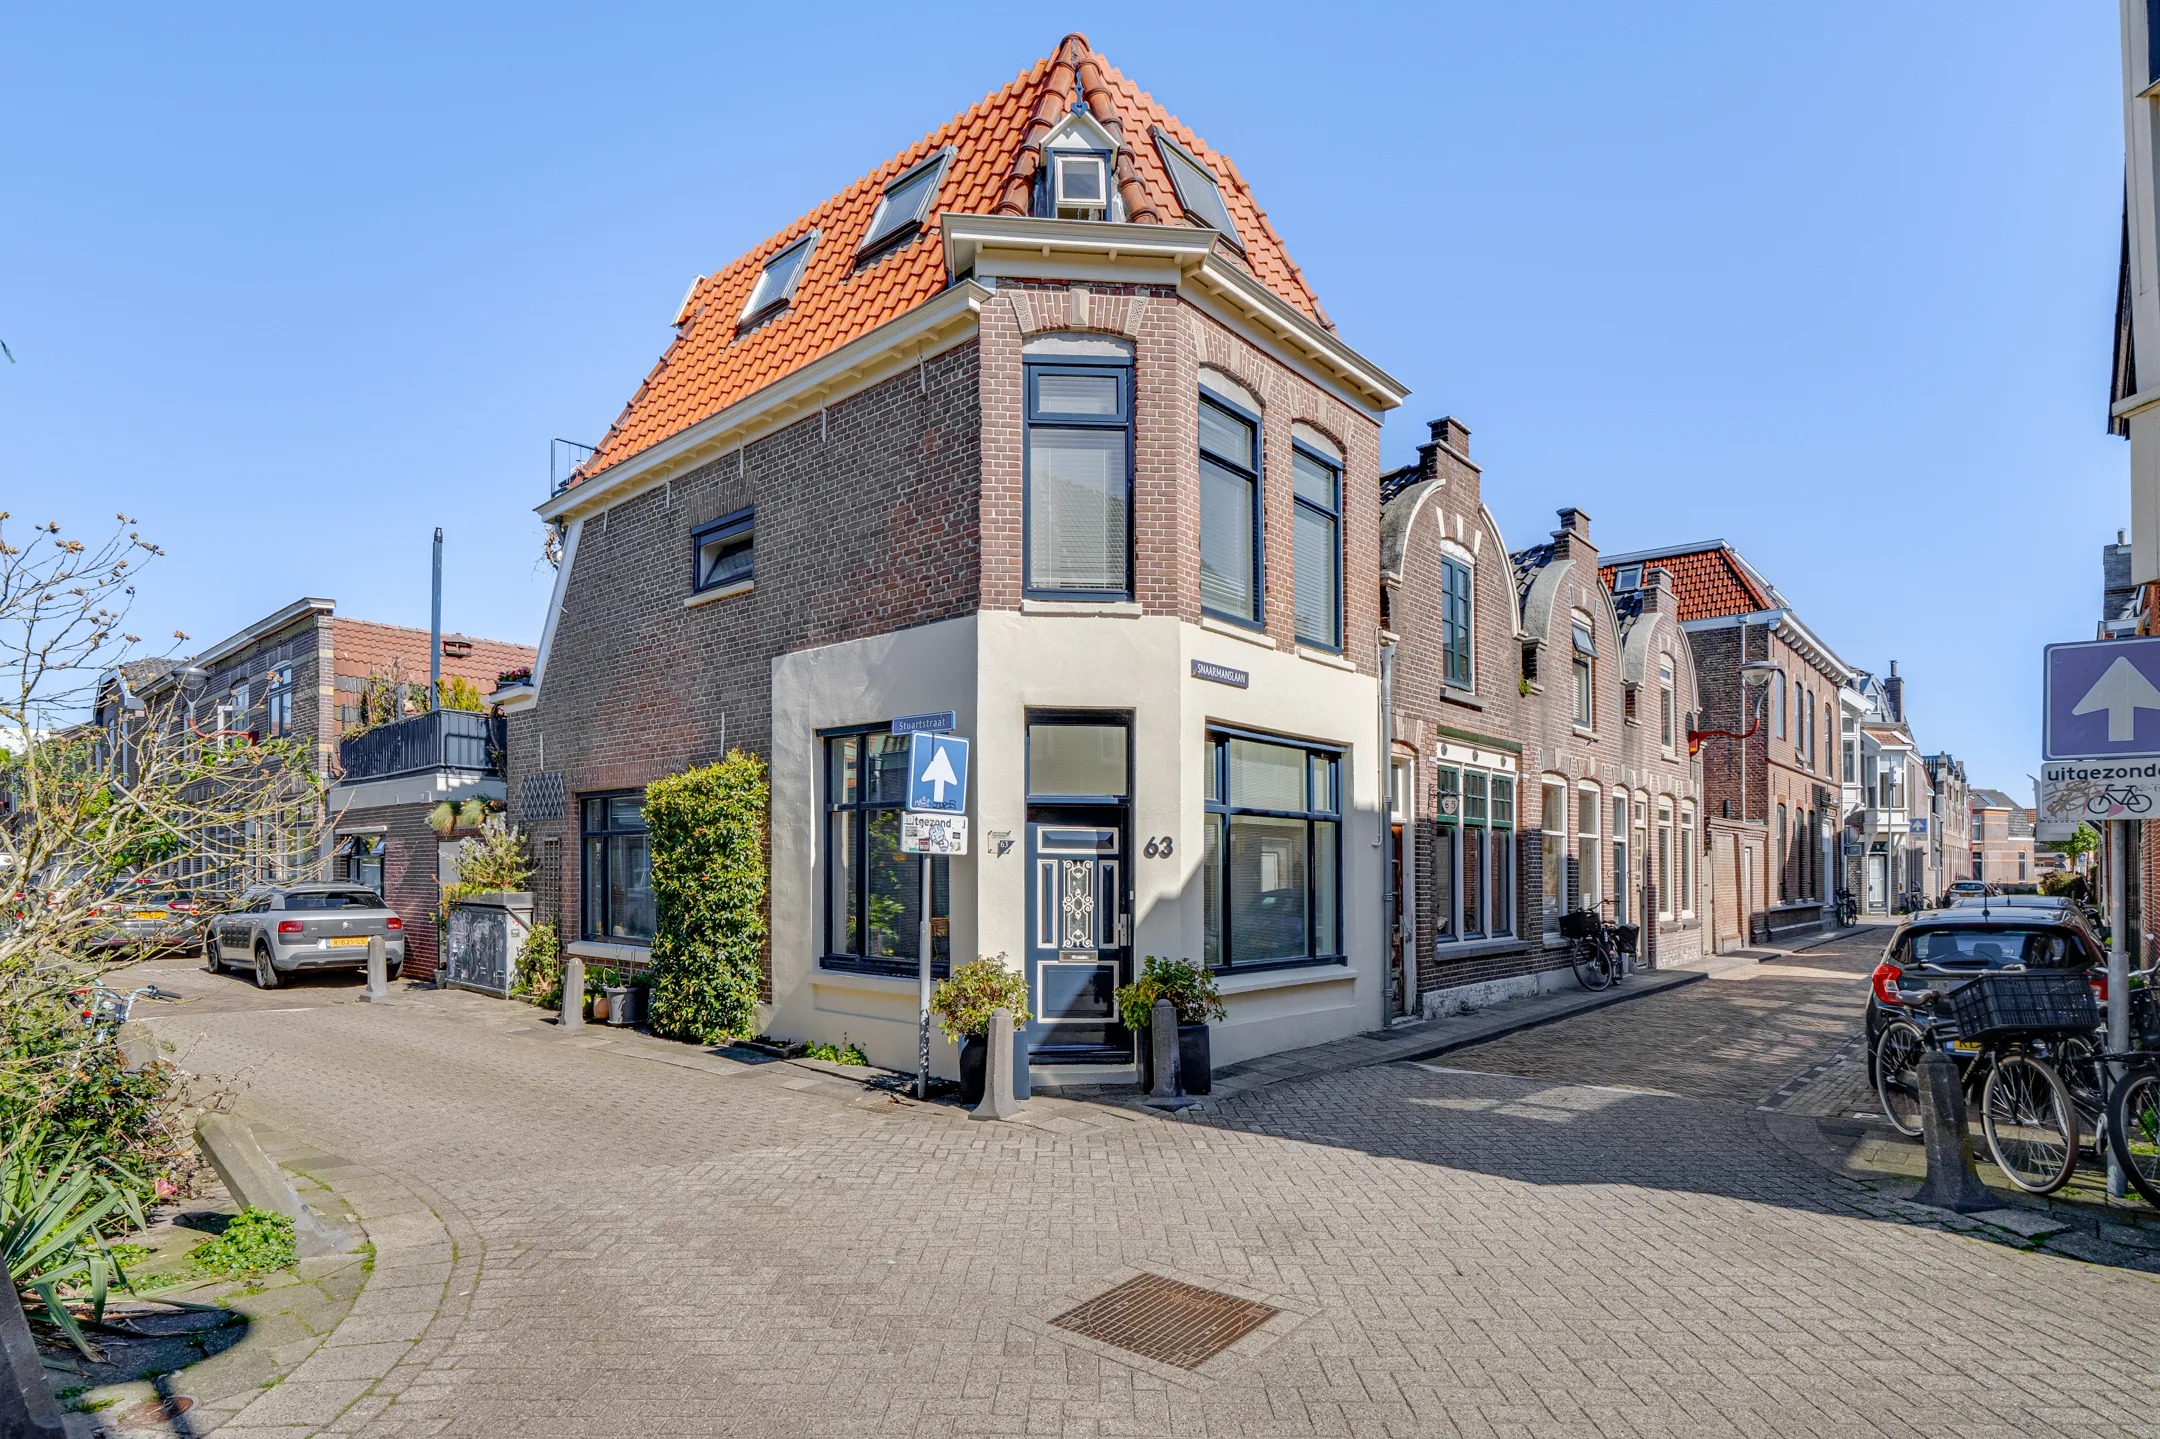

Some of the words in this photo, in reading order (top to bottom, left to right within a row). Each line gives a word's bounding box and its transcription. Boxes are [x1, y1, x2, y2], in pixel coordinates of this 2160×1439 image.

[1197, 663, 1246, 684] SNAARMANSLAAN
[899, 719, 946, 731] Stuartstraat
[2047, 763, 2160, 781] uitgezond
[1144, 836, 1174, 859] 63
